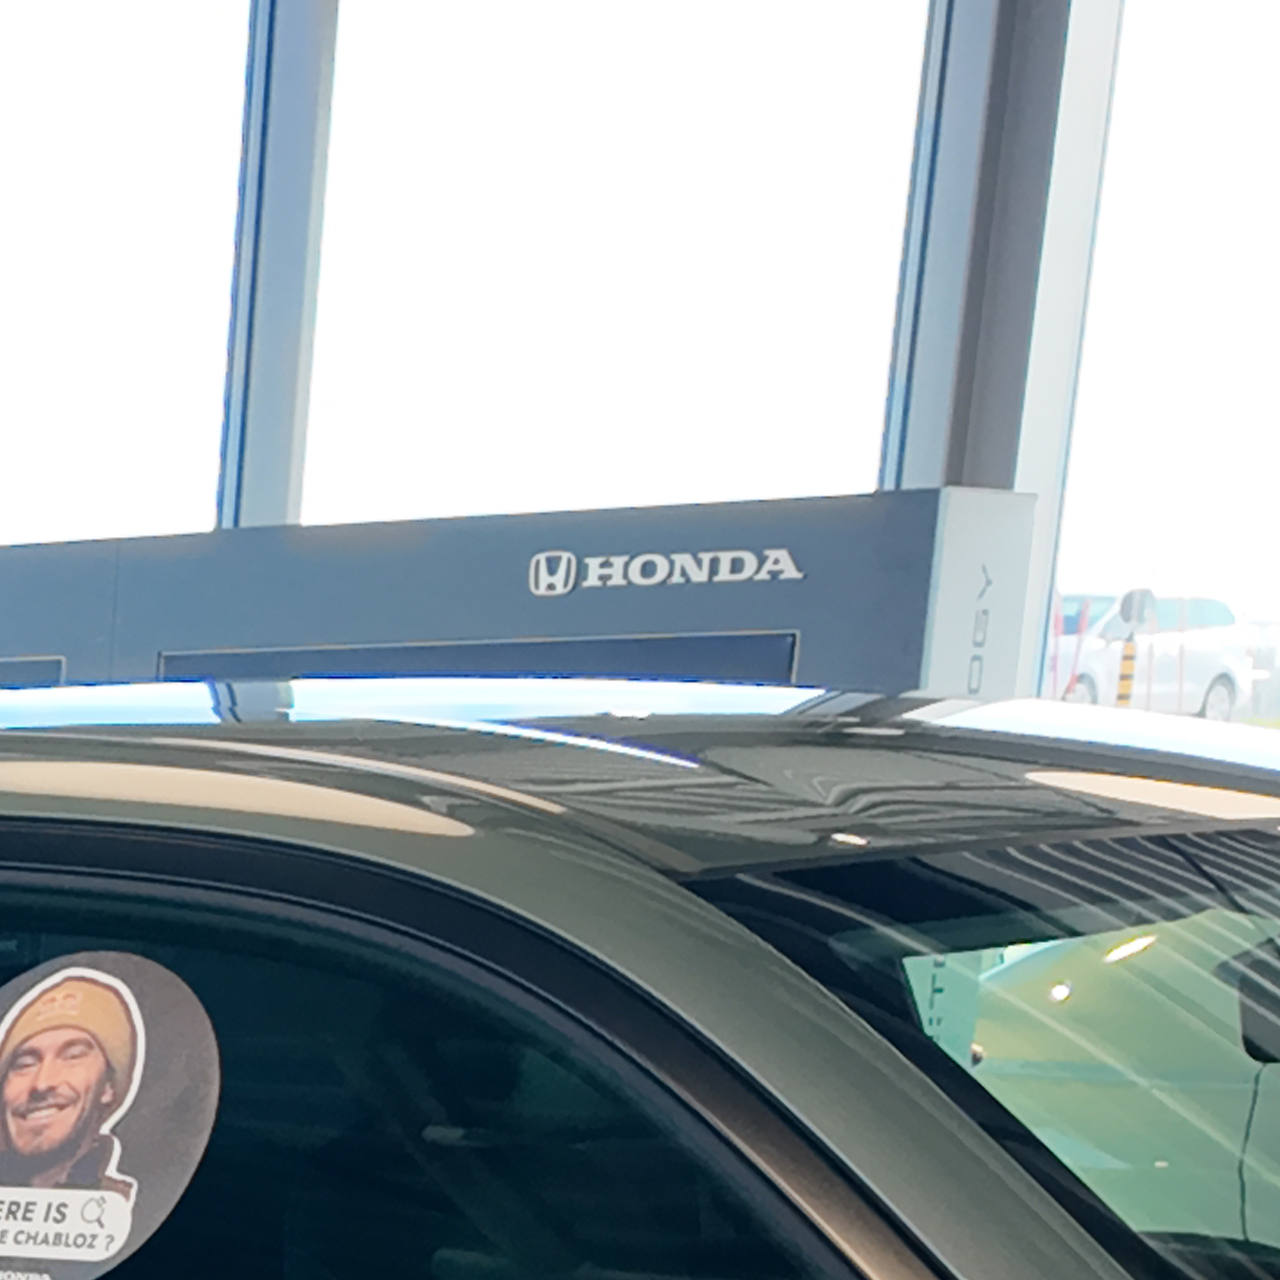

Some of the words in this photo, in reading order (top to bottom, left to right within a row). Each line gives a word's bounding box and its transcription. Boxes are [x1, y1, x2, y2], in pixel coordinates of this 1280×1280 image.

[582, 549, 805, 588] HONDA
[43, 1202, 69, 1224] IS
[13, 1230, 98, 1249] CHABLOZ
